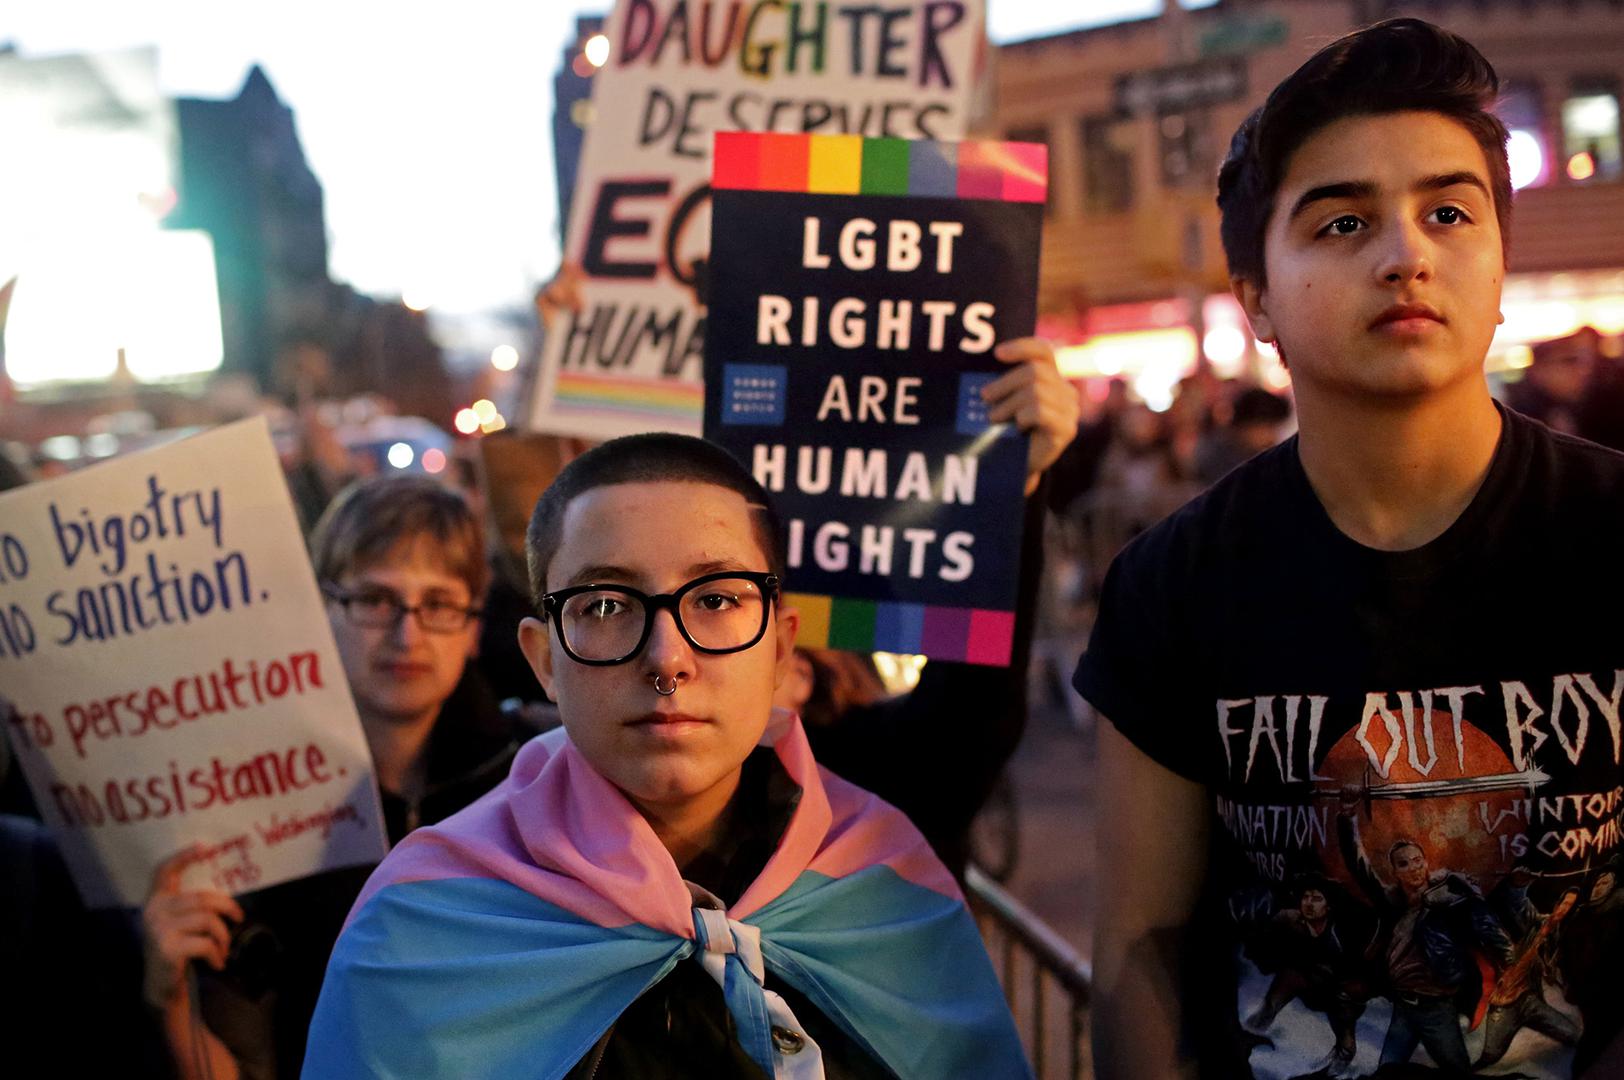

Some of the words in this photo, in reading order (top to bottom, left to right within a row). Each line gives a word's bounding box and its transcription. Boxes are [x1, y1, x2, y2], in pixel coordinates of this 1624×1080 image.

[617, 0, 965, 90] DAUGHTER
[802, 216, 964, 273] LGBT
[560, 303, 704, 376] HUMA
[756, 294, 997, 354] RIGHTS
[816, 374, 922, 424] ARE
[752, 444, 979, 505] HUMAN
[0, 533, 29, 584] o
[49, 473, 223, 576] bigotry
[787, 519, 976, 583] IGHTS
[47, 551, 270, 647] sanction.
[8, 702, 54, 750] to
[64, 651, 324, 758] persecution
[1215, 694, 1337, 783] FALL
[1355, 684, 1486, 779] OUT
[1499, 668, 1624, 772] BOY
[1499, 834, 1529, 863] IS
[1536, 812, 1624, 860] COMIN
